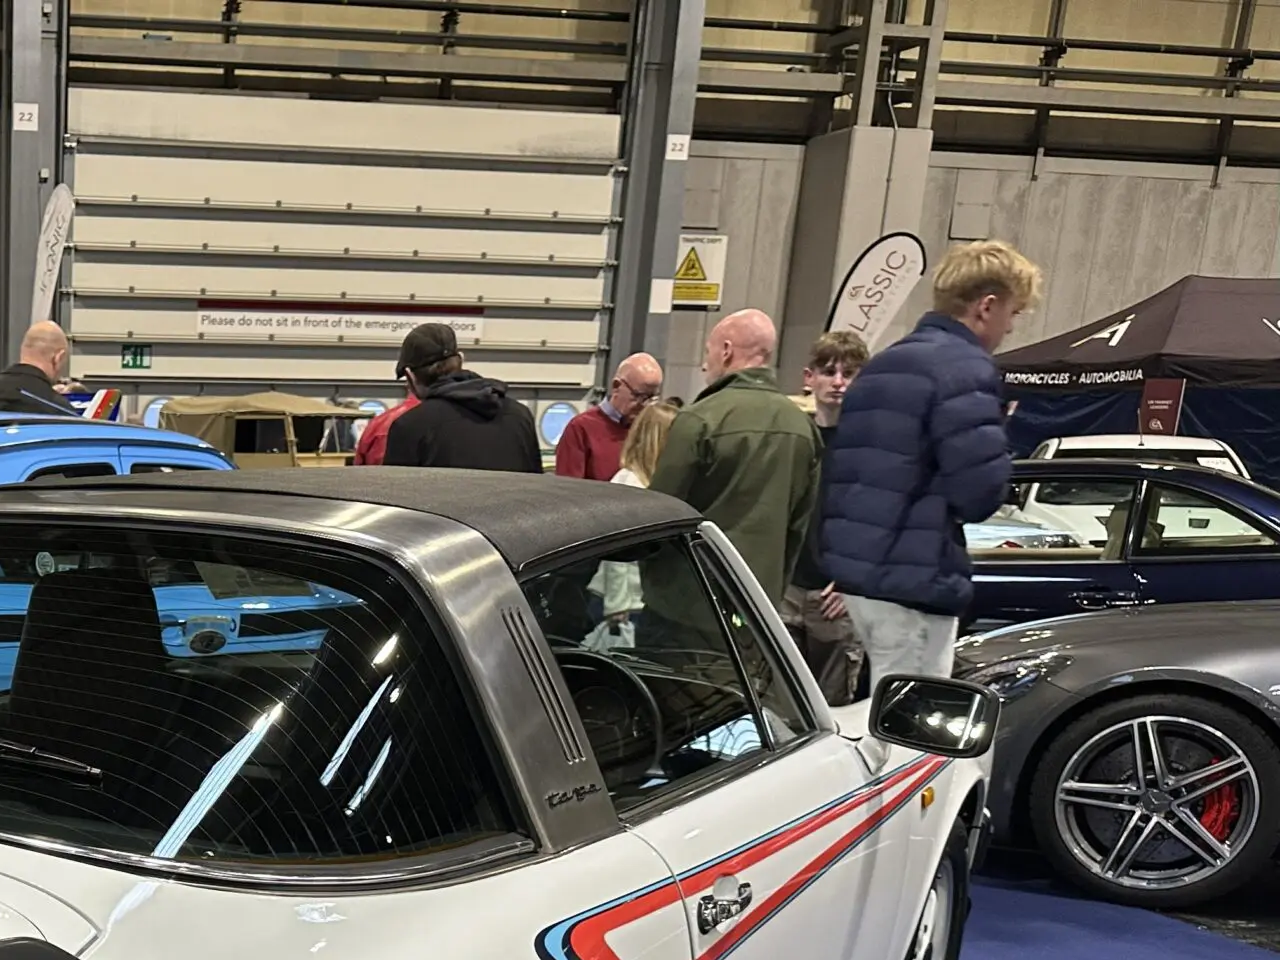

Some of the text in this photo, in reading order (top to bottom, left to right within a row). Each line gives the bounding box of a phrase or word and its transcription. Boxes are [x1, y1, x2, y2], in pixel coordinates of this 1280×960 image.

[848, 250, 907, 332] LASSIC
[201, 315, 235, 326] Please
[238, 315, 253, 327] do
[255, 316, 273, 327] not
[276, 316, 288, 327] sit
[291, 316, 301, 327] in
[304, 316, 329, 327] front
[331, 316, 344, 328] of
[345, 318, 362, 329] the
[365, 320, 419, 331] emergenc
[1004, 368, 1144, 384] MOTORCYCLES AUTOMOBILIA
